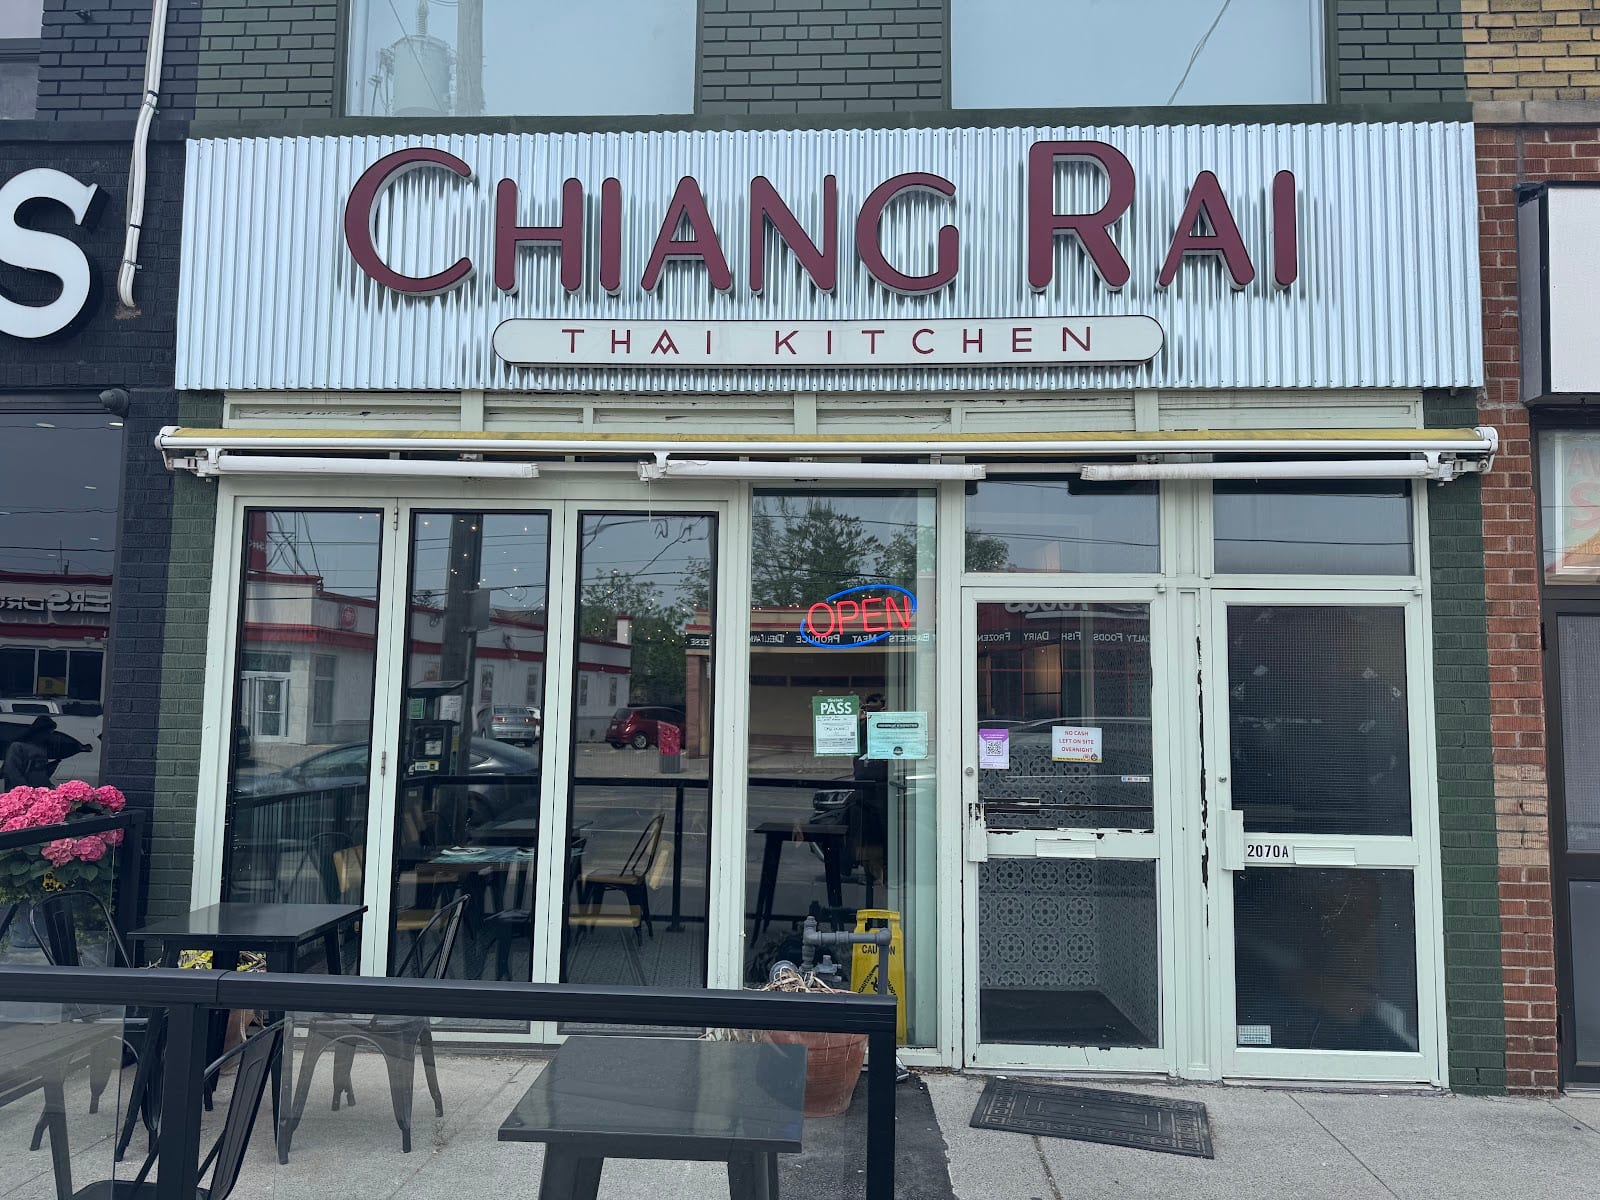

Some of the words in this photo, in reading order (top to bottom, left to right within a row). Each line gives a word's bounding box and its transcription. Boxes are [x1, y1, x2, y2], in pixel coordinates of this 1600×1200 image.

[344, 146, 961, 296] CHIANG
[1028, 139, 1298, 290] RAI
[561, 328, 712, 355] THAI
[774, 325, 1091, 355] KITCHEN
[807, 595, 911, 637] OPEN
[820, 701, 852, 715] PASS
[1248, 844, 1288, 857] 2070A
